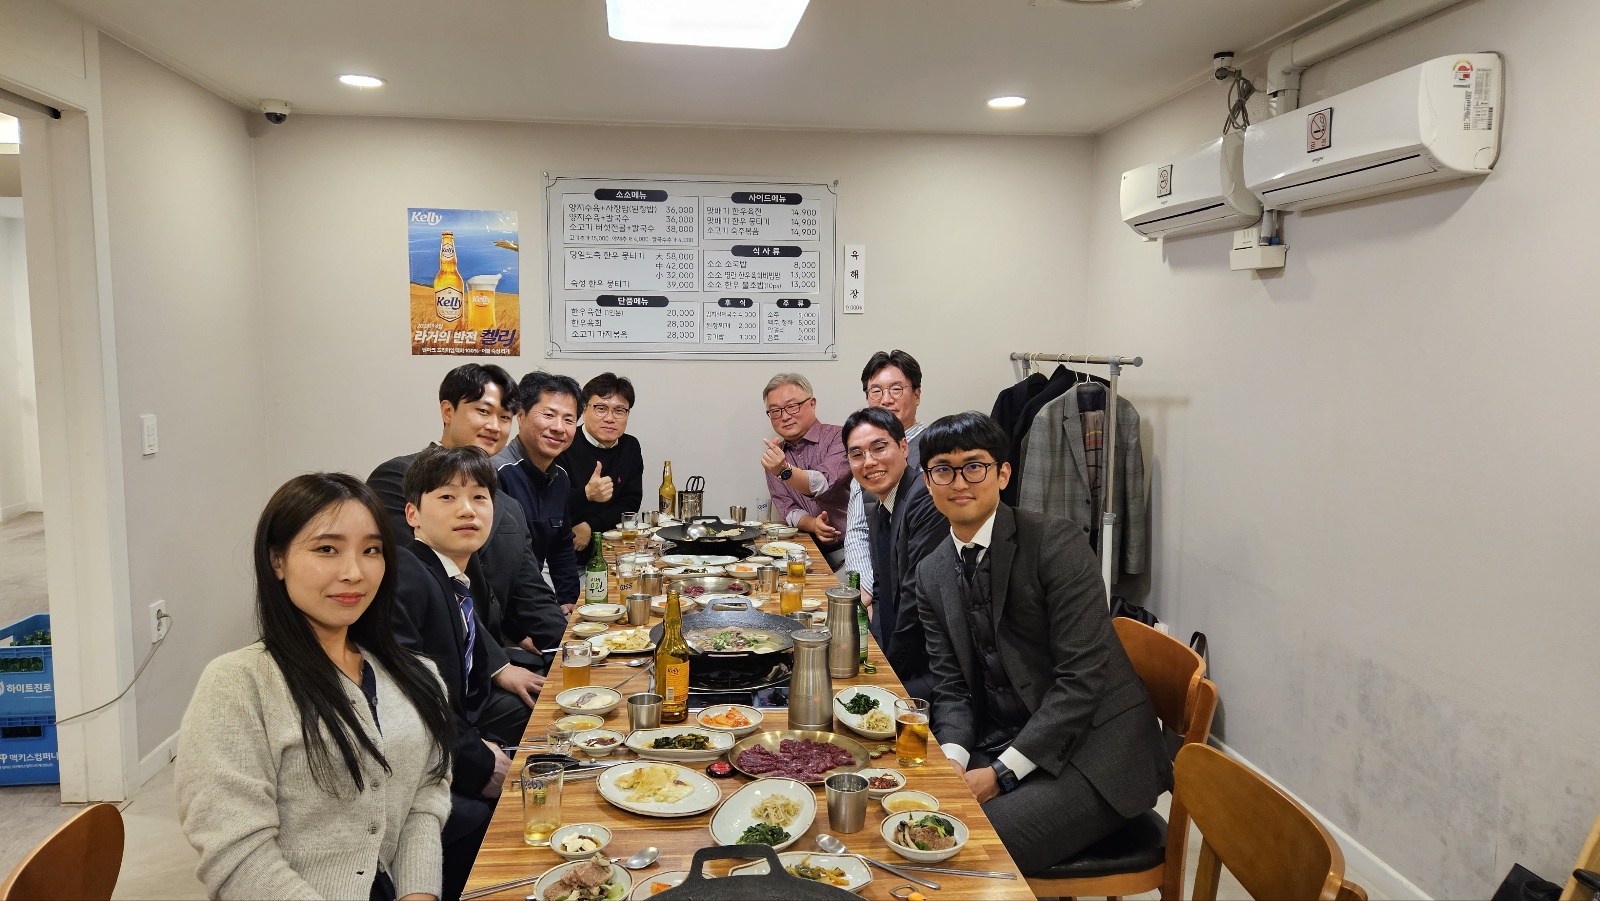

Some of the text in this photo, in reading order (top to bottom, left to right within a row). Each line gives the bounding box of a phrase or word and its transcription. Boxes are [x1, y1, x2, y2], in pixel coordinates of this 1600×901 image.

[616, 190, 647, 200] 소소메뉴
[748, 193, 786, 203] 사이드메뉴
[665, 206, 694, 215] 36,000
[732, 207, 762, 217] 한우육전
[791, 208, 817, 217] 14,900
[410, 211, 443, 226] Kelly
[665, 215, 694, 224] 36,000
[732, 217, 747, 226] 한우
[791, 218, 817, 228] 14,900
[569, 223, 593, 232] 소고기
[665, 225, 694, 234] 38,000
[706, 226, 729, 235] 소고기
[790, 228, 817, 237] 14,900
[569, 250, 601, 260] 당일도축
[603, 251, 619, 260] 한우
[655, 252, 664, 260] 大
[666, 252, 694, 261] 58,000
[655, 261, 694, 271] 中 42,000
[707, 260, 816, 270] 소소 소국밥 8,000
[655, 271, 694, 280] 小 32,000
[707, 271, 723, 279] 소소
[570, 279, 586, 288] 숙성
[588, 279, 604, 288] 한우
[666, 281, 694, 289] 39,000
[707, 280, 723, 289] 소소
[724, 281, 740, 290] 한우
[436, 296, 463, 311] Kelly
[472, 295, 492, 305] Kelly
[617, 296, 649, 306] 단품메뉴
[570, 308, 602, 317] 한우육전
[666, 309, 695, 318] 20,000
[570, 318, 695, 329] 한우육회 28,000
[798, 319, 816, 327] 5,000
[413, 328, 517, 348] 라거의 반전 켈리
[571, 330, 695, 340] 소고기 가지볶음 28,000
[667, 667, 680, 675] Kelly
[6, 682, 53, 694] 하이트진로
[9, 752, 59, 763] 맥키스컴퍼니
